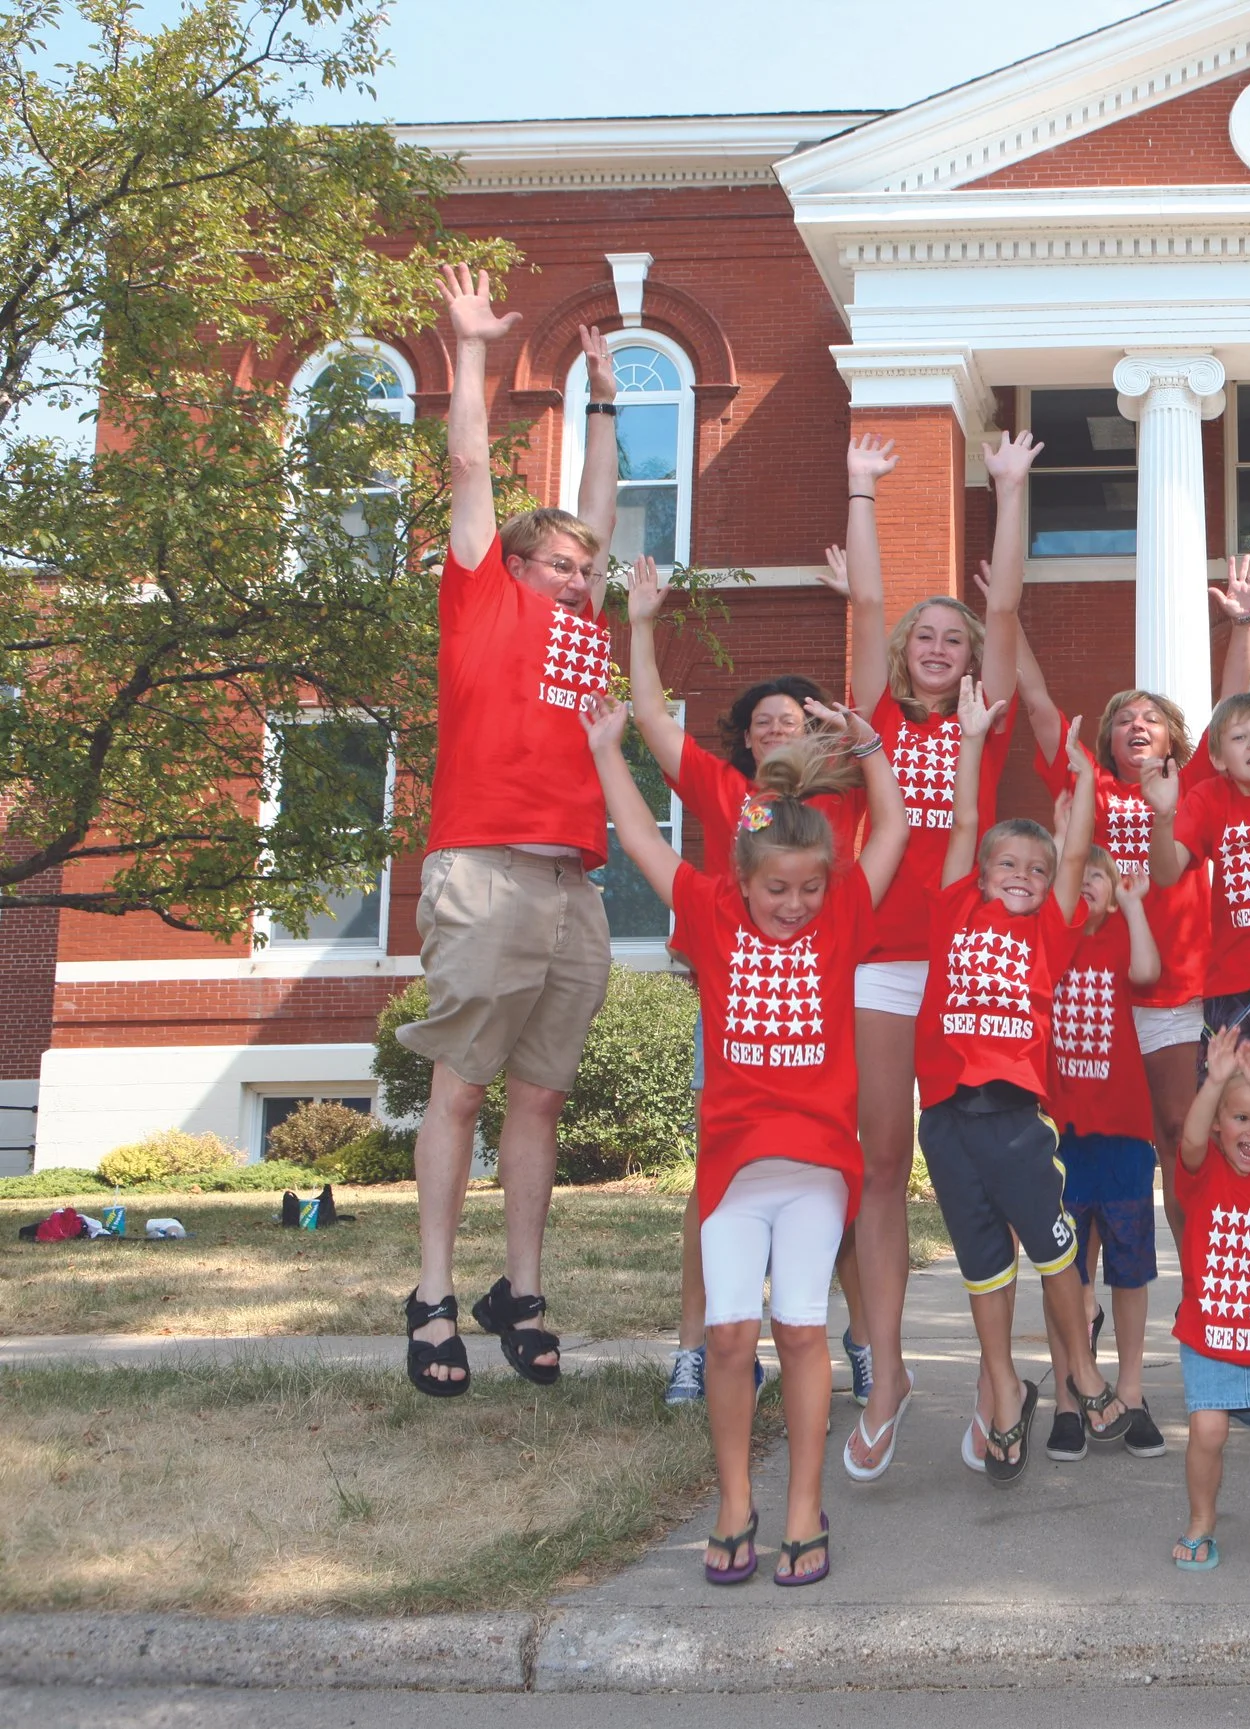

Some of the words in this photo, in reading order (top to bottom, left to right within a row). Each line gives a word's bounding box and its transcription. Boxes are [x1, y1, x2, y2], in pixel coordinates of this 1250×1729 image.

[539, 682, 546, 700] I
[547, 685, 577, 709] SEE
[926, 808, 953, 828] STA
[943, 1013, 976, 1035] SEE
[979, 1014, 1033, 1039] STARS
[730, 1041, 764, 1066] SEE
[769, 1042, 825, 1067] STARS
[1067, 1057, 1110, 1080] STARS
[1204, 1324, 1234, 1350] SEE
